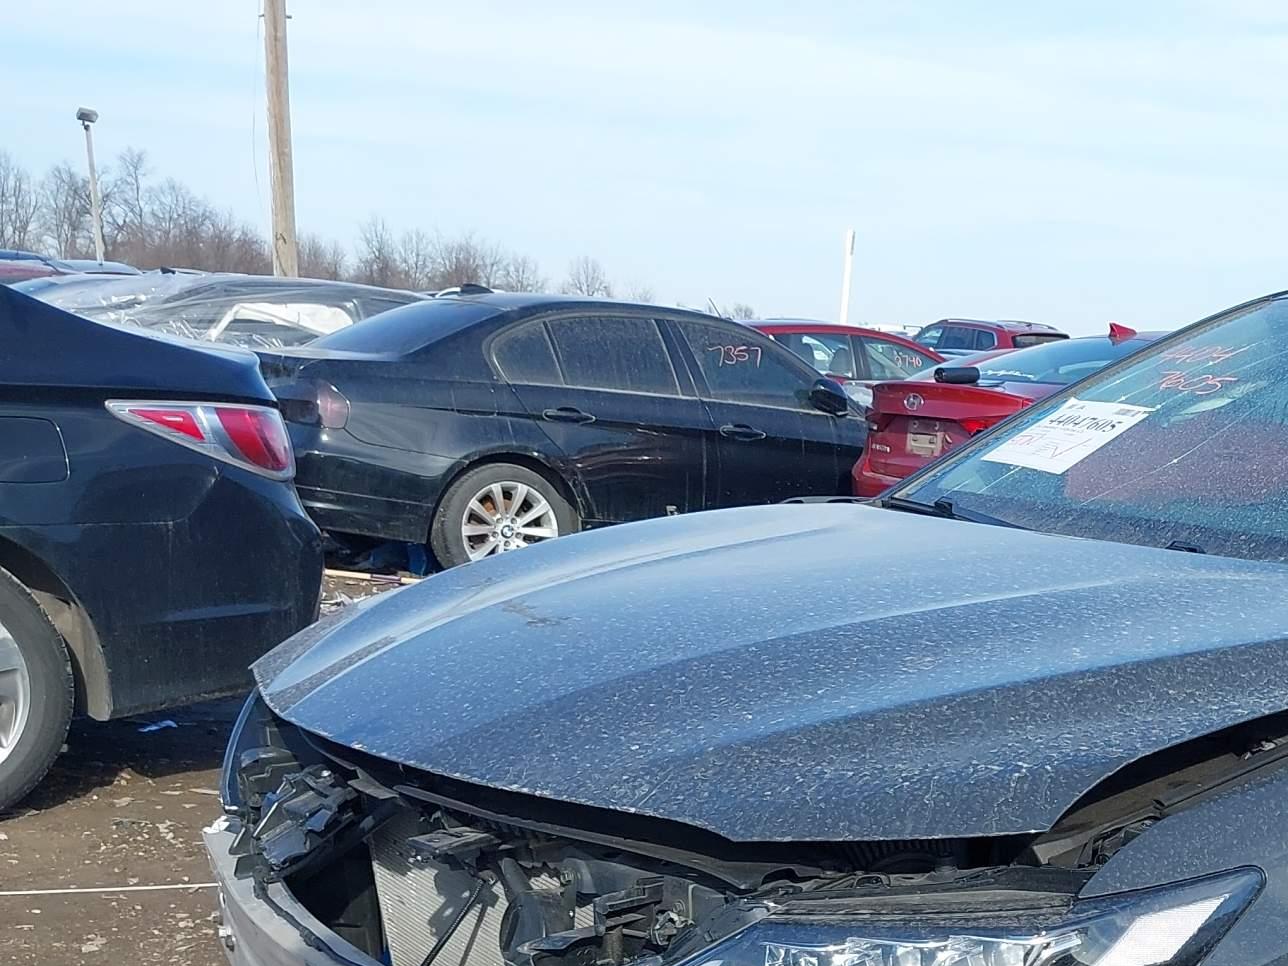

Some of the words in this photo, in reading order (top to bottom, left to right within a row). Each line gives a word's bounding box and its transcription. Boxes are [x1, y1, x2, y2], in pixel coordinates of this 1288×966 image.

[707, 345, 762, 369] 7357
[1160, 371, 1239, 395] 7605
[1048, 413, 1124, 433] 44047605
